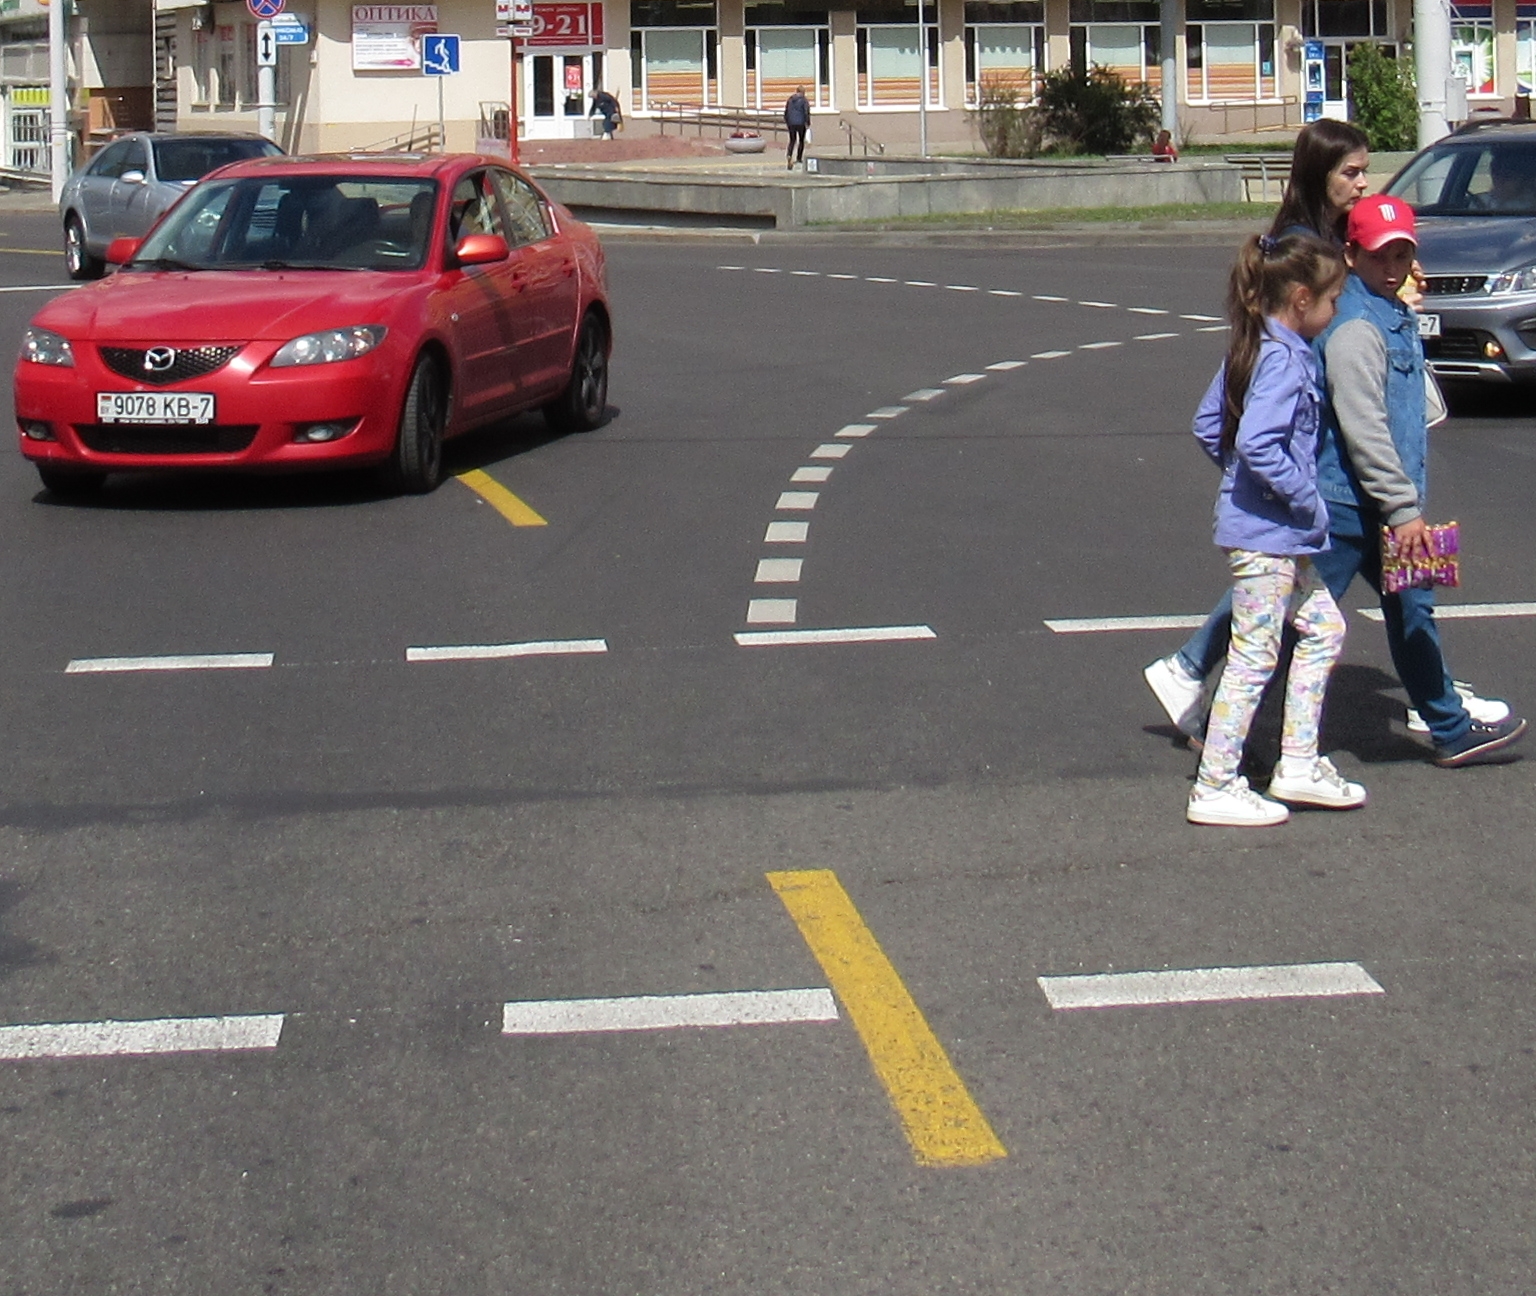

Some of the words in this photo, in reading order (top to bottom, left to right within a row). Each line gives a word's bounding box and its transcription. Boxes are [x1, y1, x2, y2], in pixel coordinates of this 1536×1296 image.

[355, 6, 435, 21] ОПТИКА
[532, 14, 586, 35] 9-21
[1418, 316, 1437, 333] -7
[115, 395, 156, 416] 9078
[164, 396, 211, 418] KB-7
